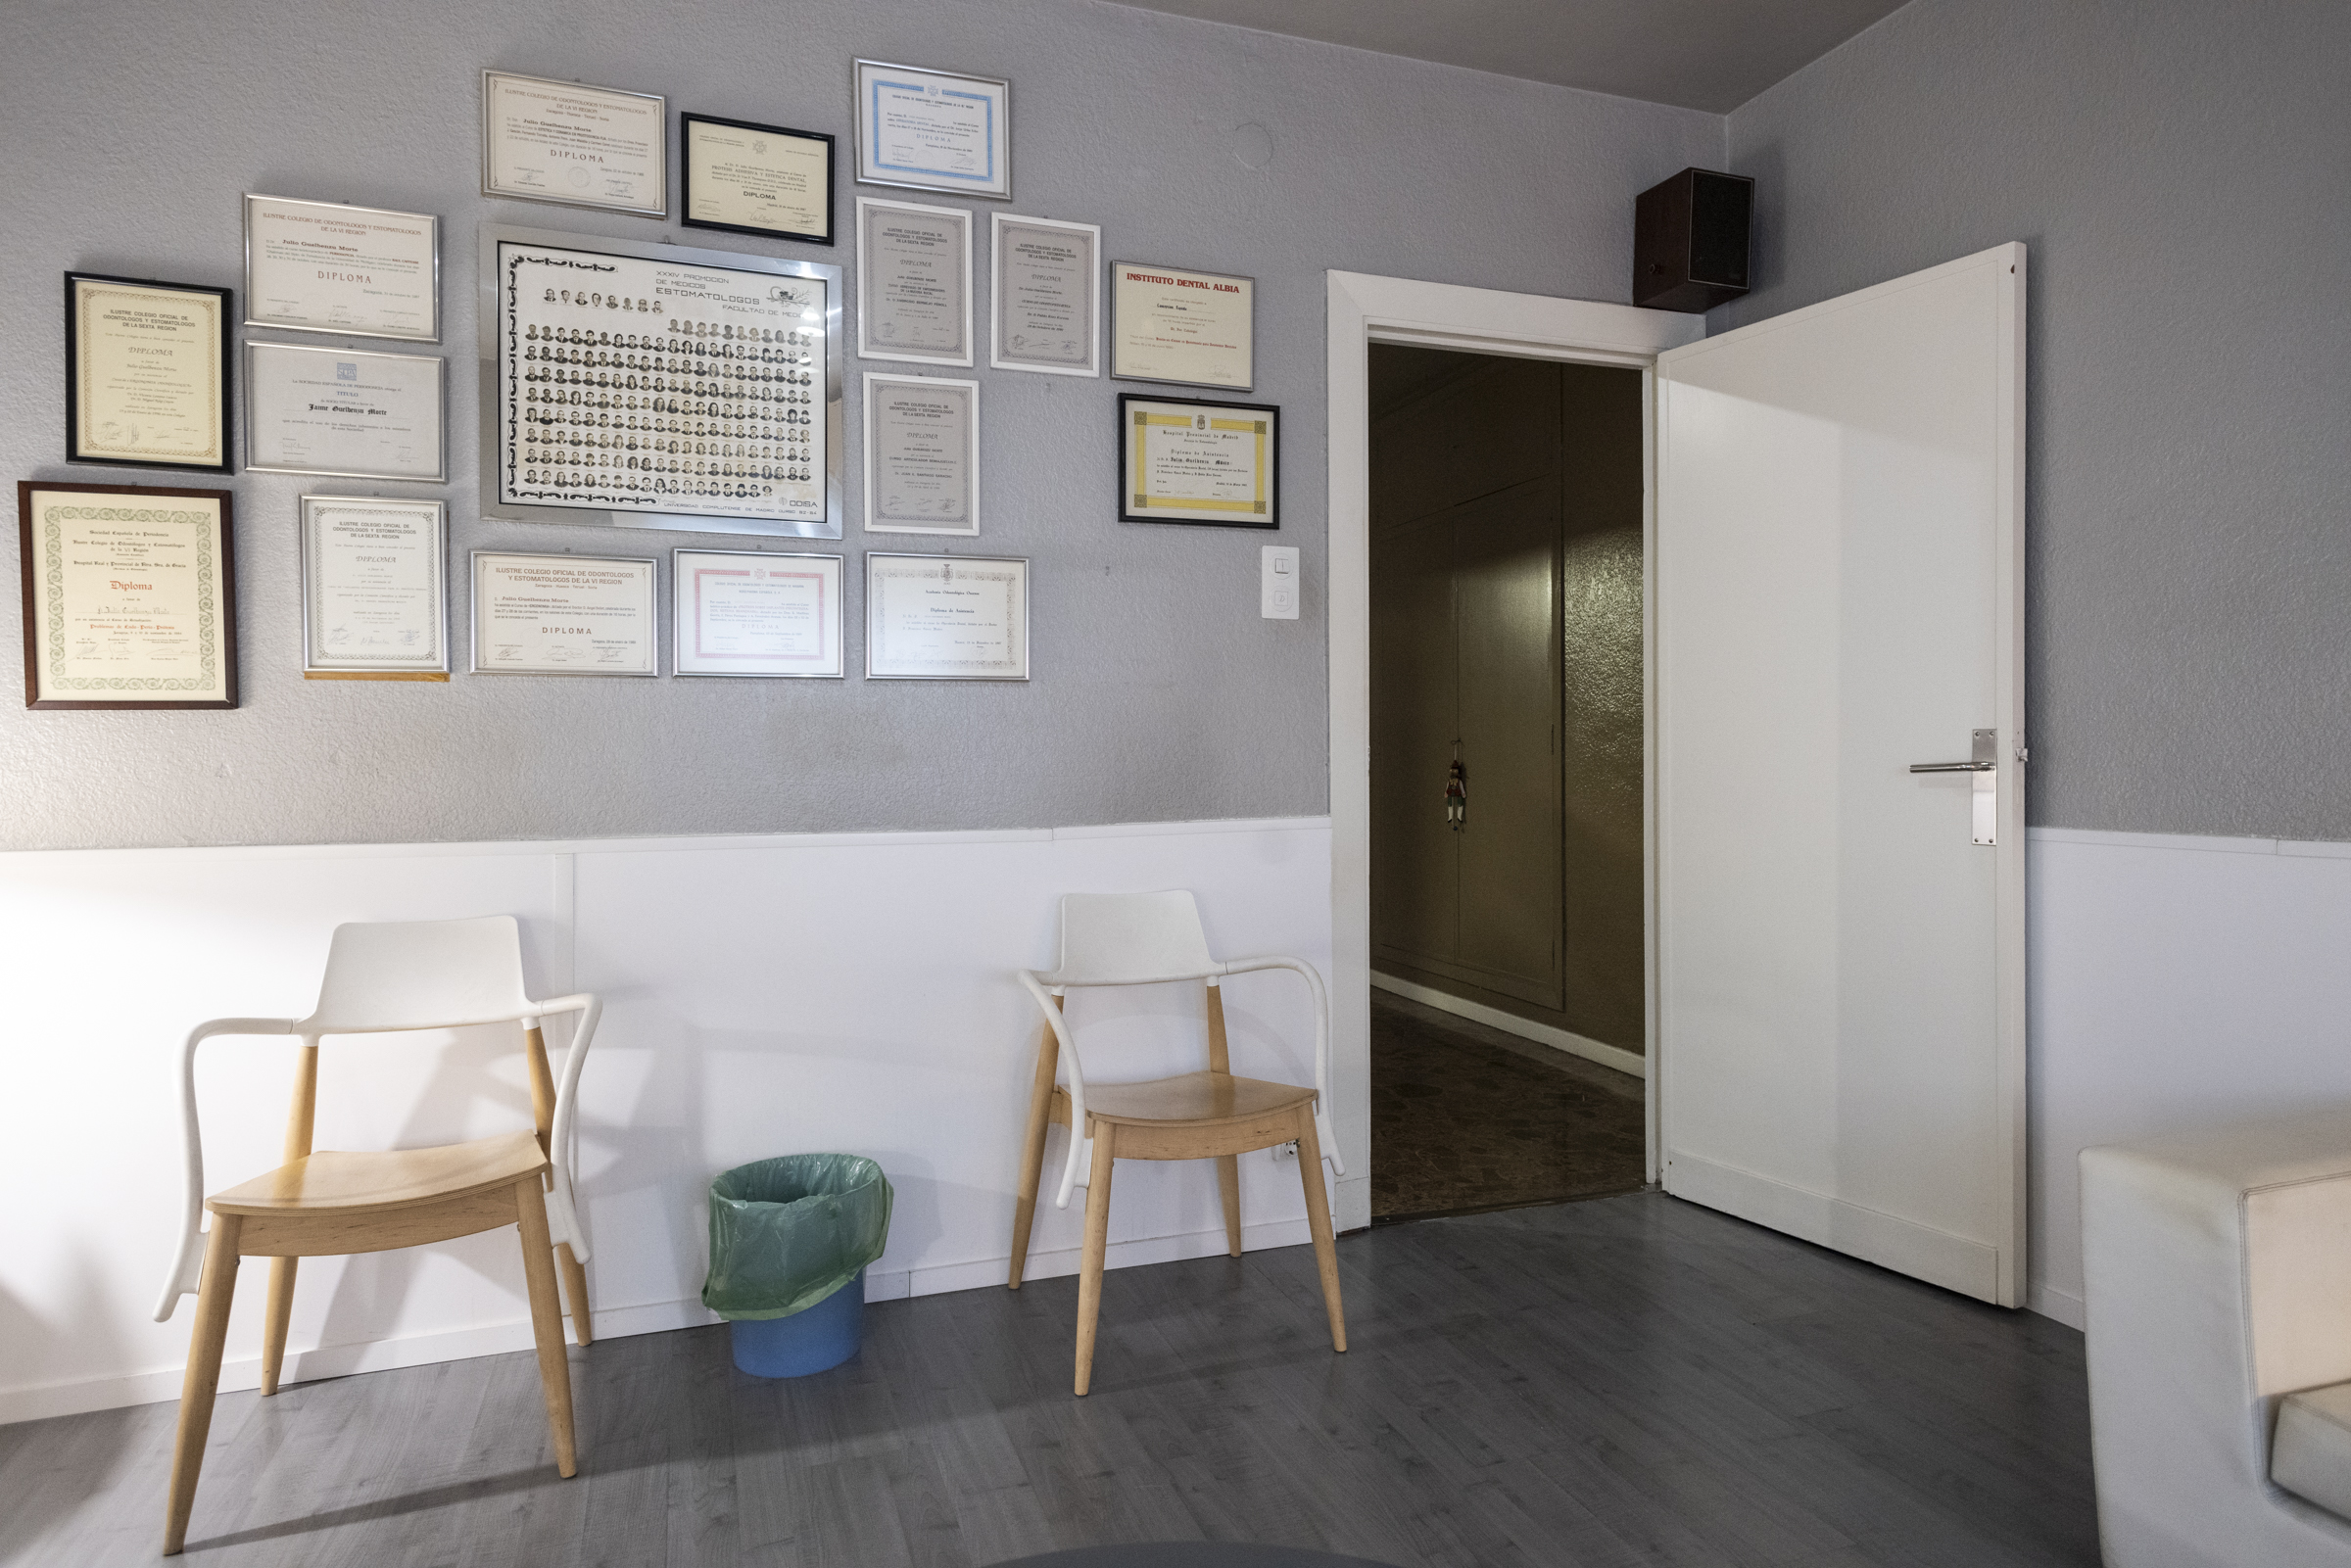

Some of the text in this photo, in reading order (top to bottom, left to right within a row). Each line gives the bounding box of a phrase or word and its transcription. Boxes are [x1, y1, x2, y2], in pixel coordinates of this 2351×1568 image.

[917, 134, 950, 143] DIPLOMA
[550, 150, 604, 163] DIPLOMA
[744, 191, 776, 200] DIPLOMA
[900, 259, 932, 268] DIPLOMA
[318, 271, 371, 284] DIPLOMA
[684, 274, 729, 284] PROMOCION
[671, 281, 706, 289] MEDICOS
[1127, 273, 1239, 293] INSTITUTO DENTAL ALBIA
[656, 288, 759, 305] ESTOMATOLOGOS
[722, 305, 764, 314] FACULTAD
[151, 319, 195, 327] ESTOMATOLOGOS
[128, 346, 173, 356] DIPLOMA
[110, 581, 152, 592] Diploma
